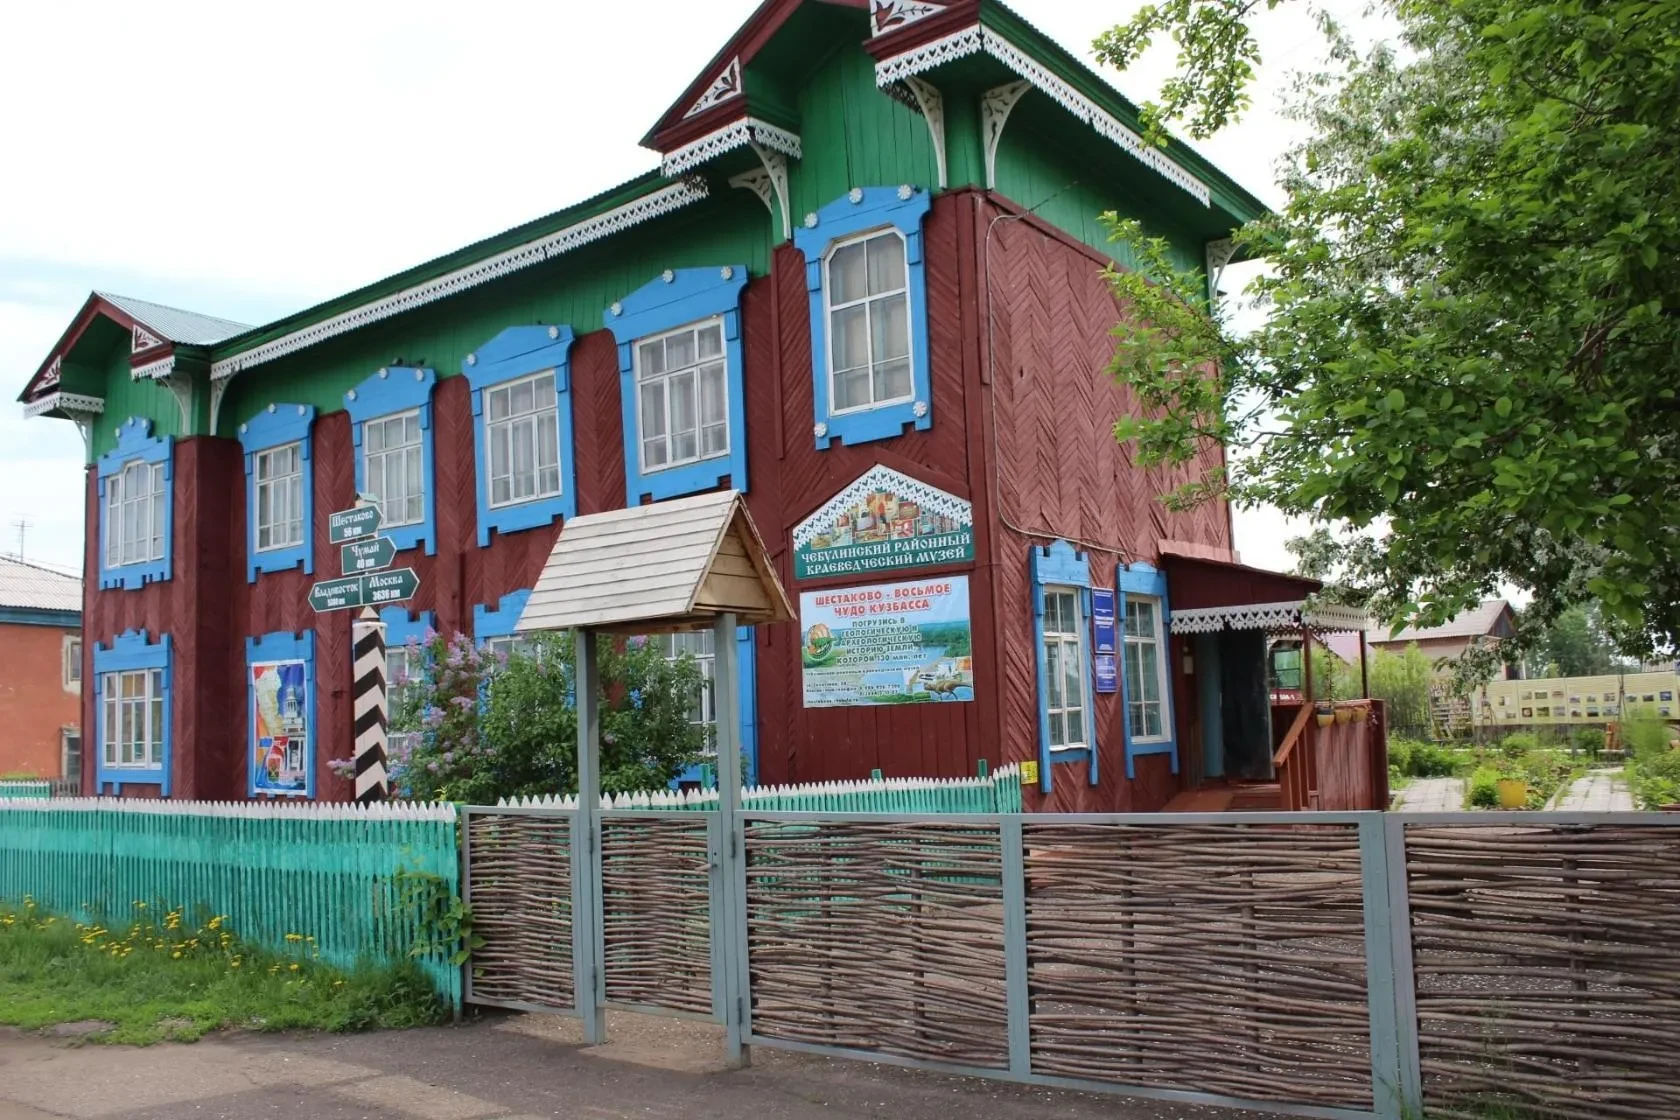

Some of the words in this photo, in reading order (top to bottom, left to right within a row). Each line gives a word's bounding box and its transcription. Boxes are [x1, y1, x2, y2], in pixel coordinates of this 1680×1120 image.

[332, 510, 374, 527] Шестаково
[353, 526, 362, 535] км
[351, 542, 379, 558] Чумай
[801, 544, 891, 564] ЧЕБУЛИНСКИЙ
[894, 532, 970, 551] РАЙОННЫЙ
[356, 559, 364, 569] 40
[365, 558, 375, 568] км
[806, 553, 913, 576] КРАЕВЕДЧЕСКИЙ
[916, 546, 965, 564] МУЗЕЙ
[369, 576, 403, 588] Москва
[390, 589, 400, 598] км
[815, 590, 882, 606] ШЕСТАКОВО
[894, 583, 951, 598] ВОСЬМОЕ
[834, 603, 865, 617] ЧУДО
[869, 599, 930, 613] КУЗБАССА
[852, 618, 897, 628] ПОГРУЗИСЬ
[841, 626, 910, 637] ГЕОЛОГИЧЕСКУЮ
[841, 634, 920, 646] АРХЕОЛОГИЧЕСКУЮ
[846, 646, 884, 654] ИСТОРИЮ
[836, 655, 874, 664] КОТОРОЙ
